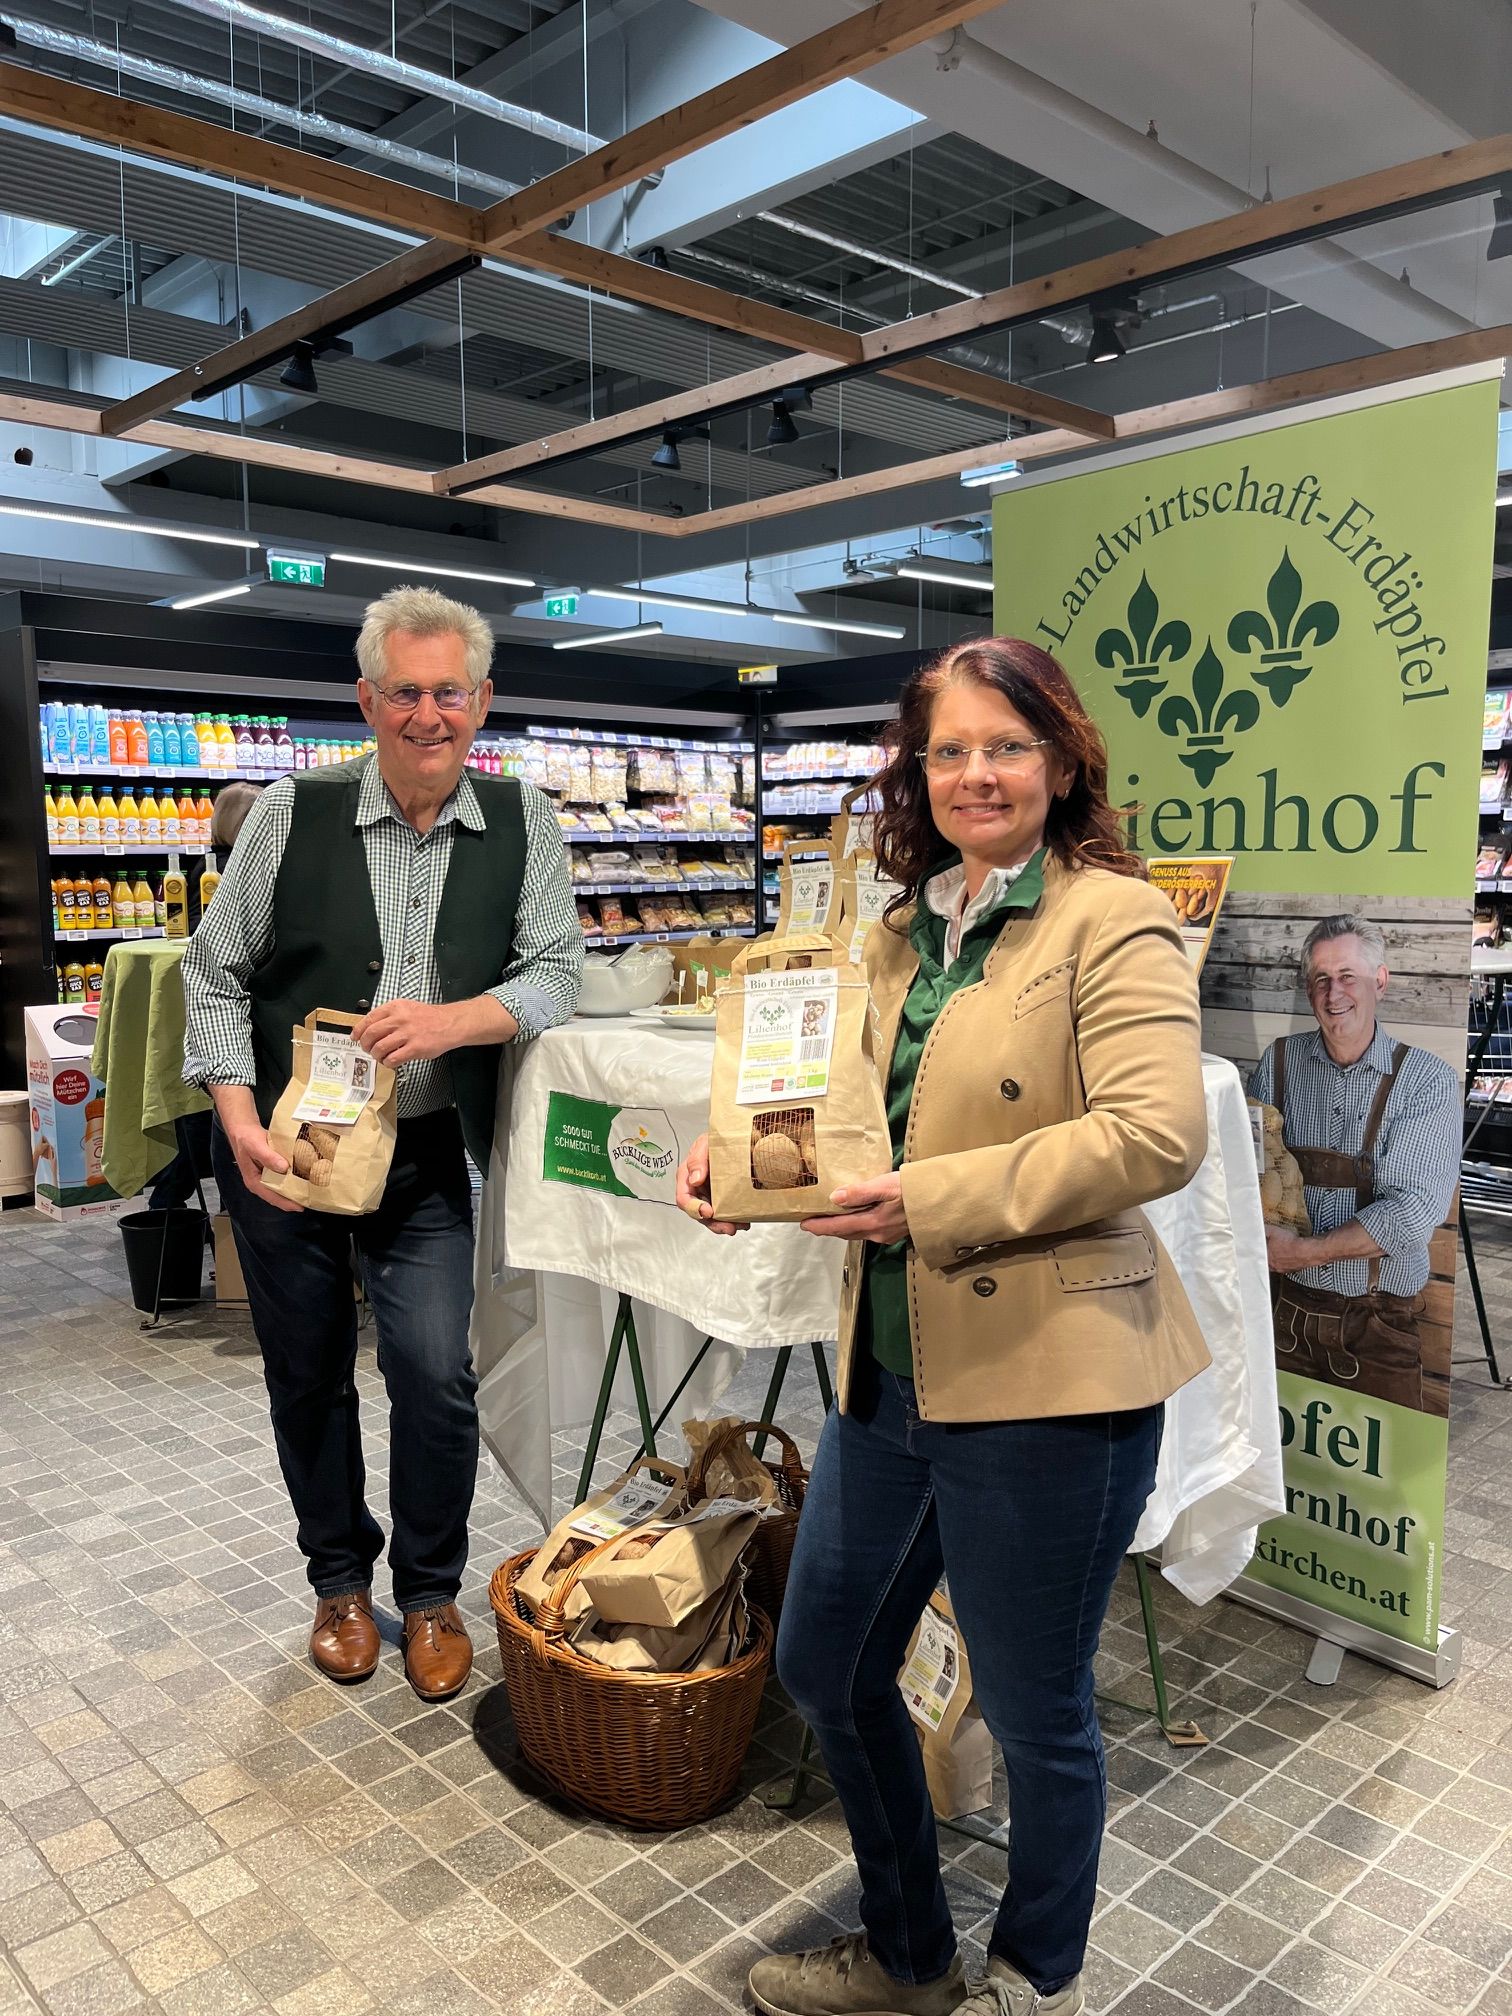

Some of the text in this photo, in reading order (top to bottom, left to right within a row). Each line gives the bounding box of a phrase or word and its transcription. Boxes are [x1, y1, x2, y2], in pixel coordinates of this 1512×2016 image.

[1120, 762, 1446, 854] ienhof
[1150, 867, 1192, 877] GENUSS AUS
[750, 976, 815, 989] Bio Erdäpfel
[317, 1035, 329, 1043] Bio
[562, 1124, 593, 1140] SOOO GUT
[554, 1136, 591, 1153] SCHMECKT
[612, 1145, 674, 1168] BUCKLIGE WELT
[1279, 1401, 1384, 1478] fel
[1285, 1485, 1416, 1556] rnhof
[1425, 1541, 1436, 1636] www.pam-solutions.at
